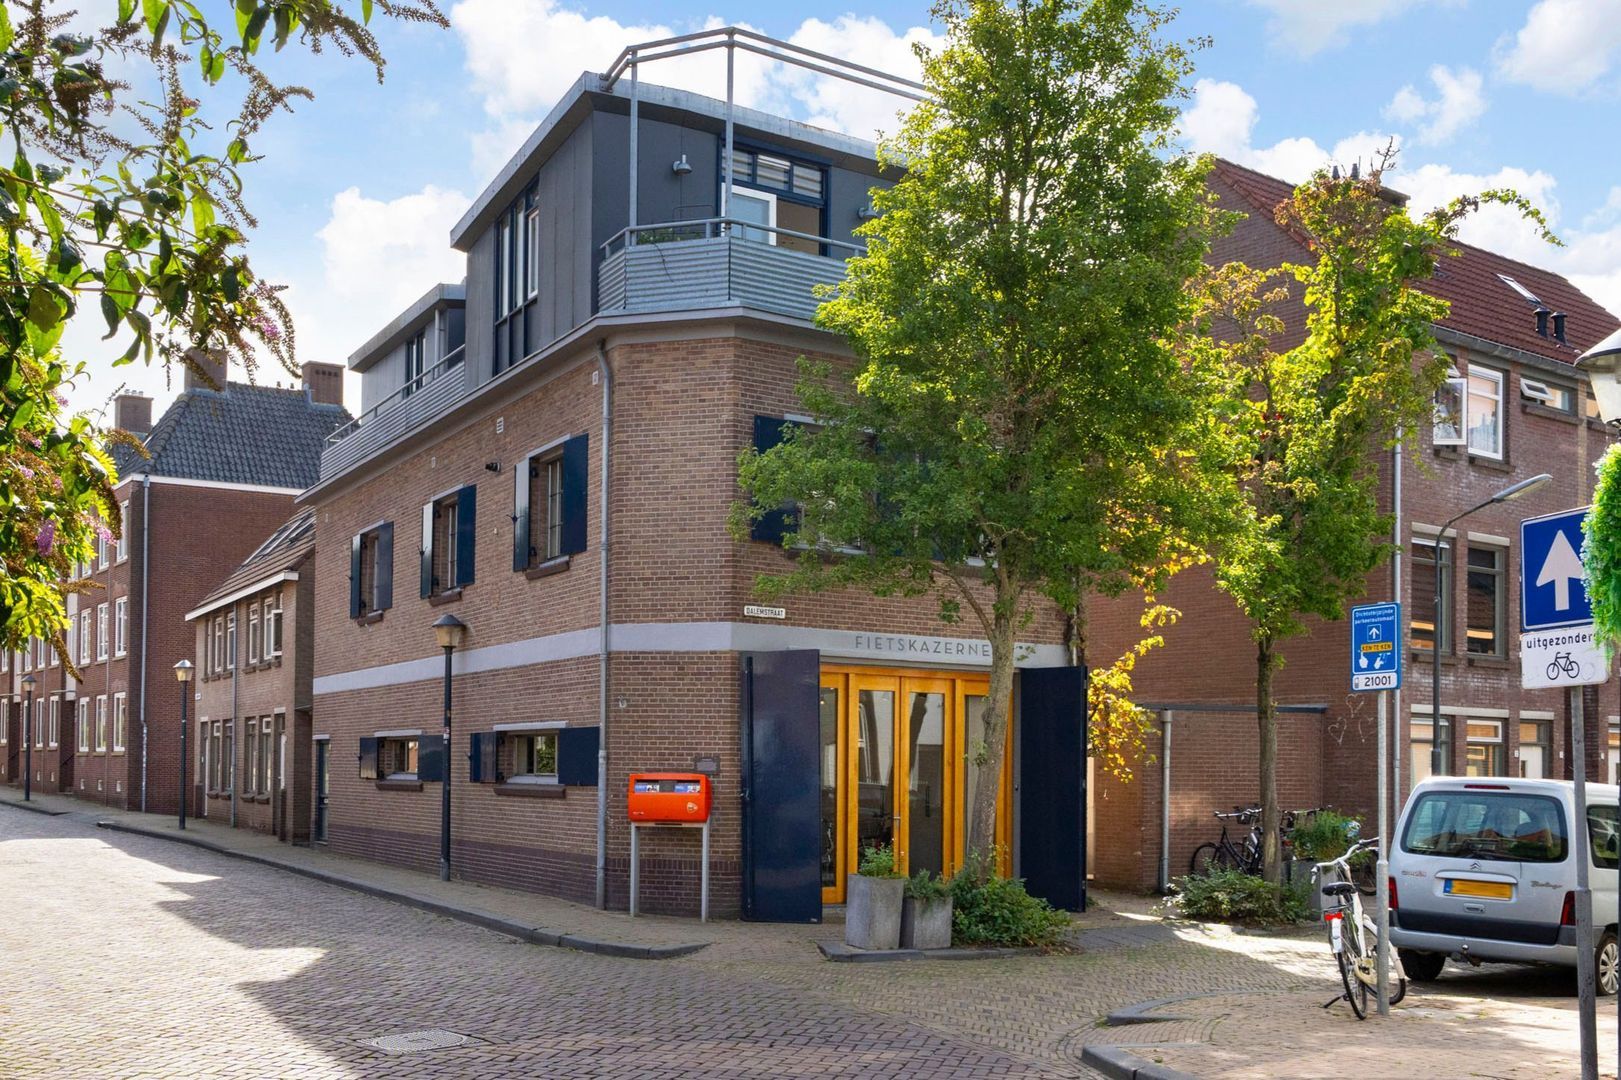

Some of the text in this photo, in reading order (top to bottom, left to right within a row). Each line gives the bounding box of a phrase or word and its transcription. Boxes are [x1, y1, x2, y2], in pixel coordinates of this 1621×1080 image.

[745, 607, 784, 617] DALEMSTRAAT
[855, 635, 990, 657] FIETSKAZERNE
[1526, 633, 1597, 650] uitgezonder
[1364, 675, 1391, 687] 21001
